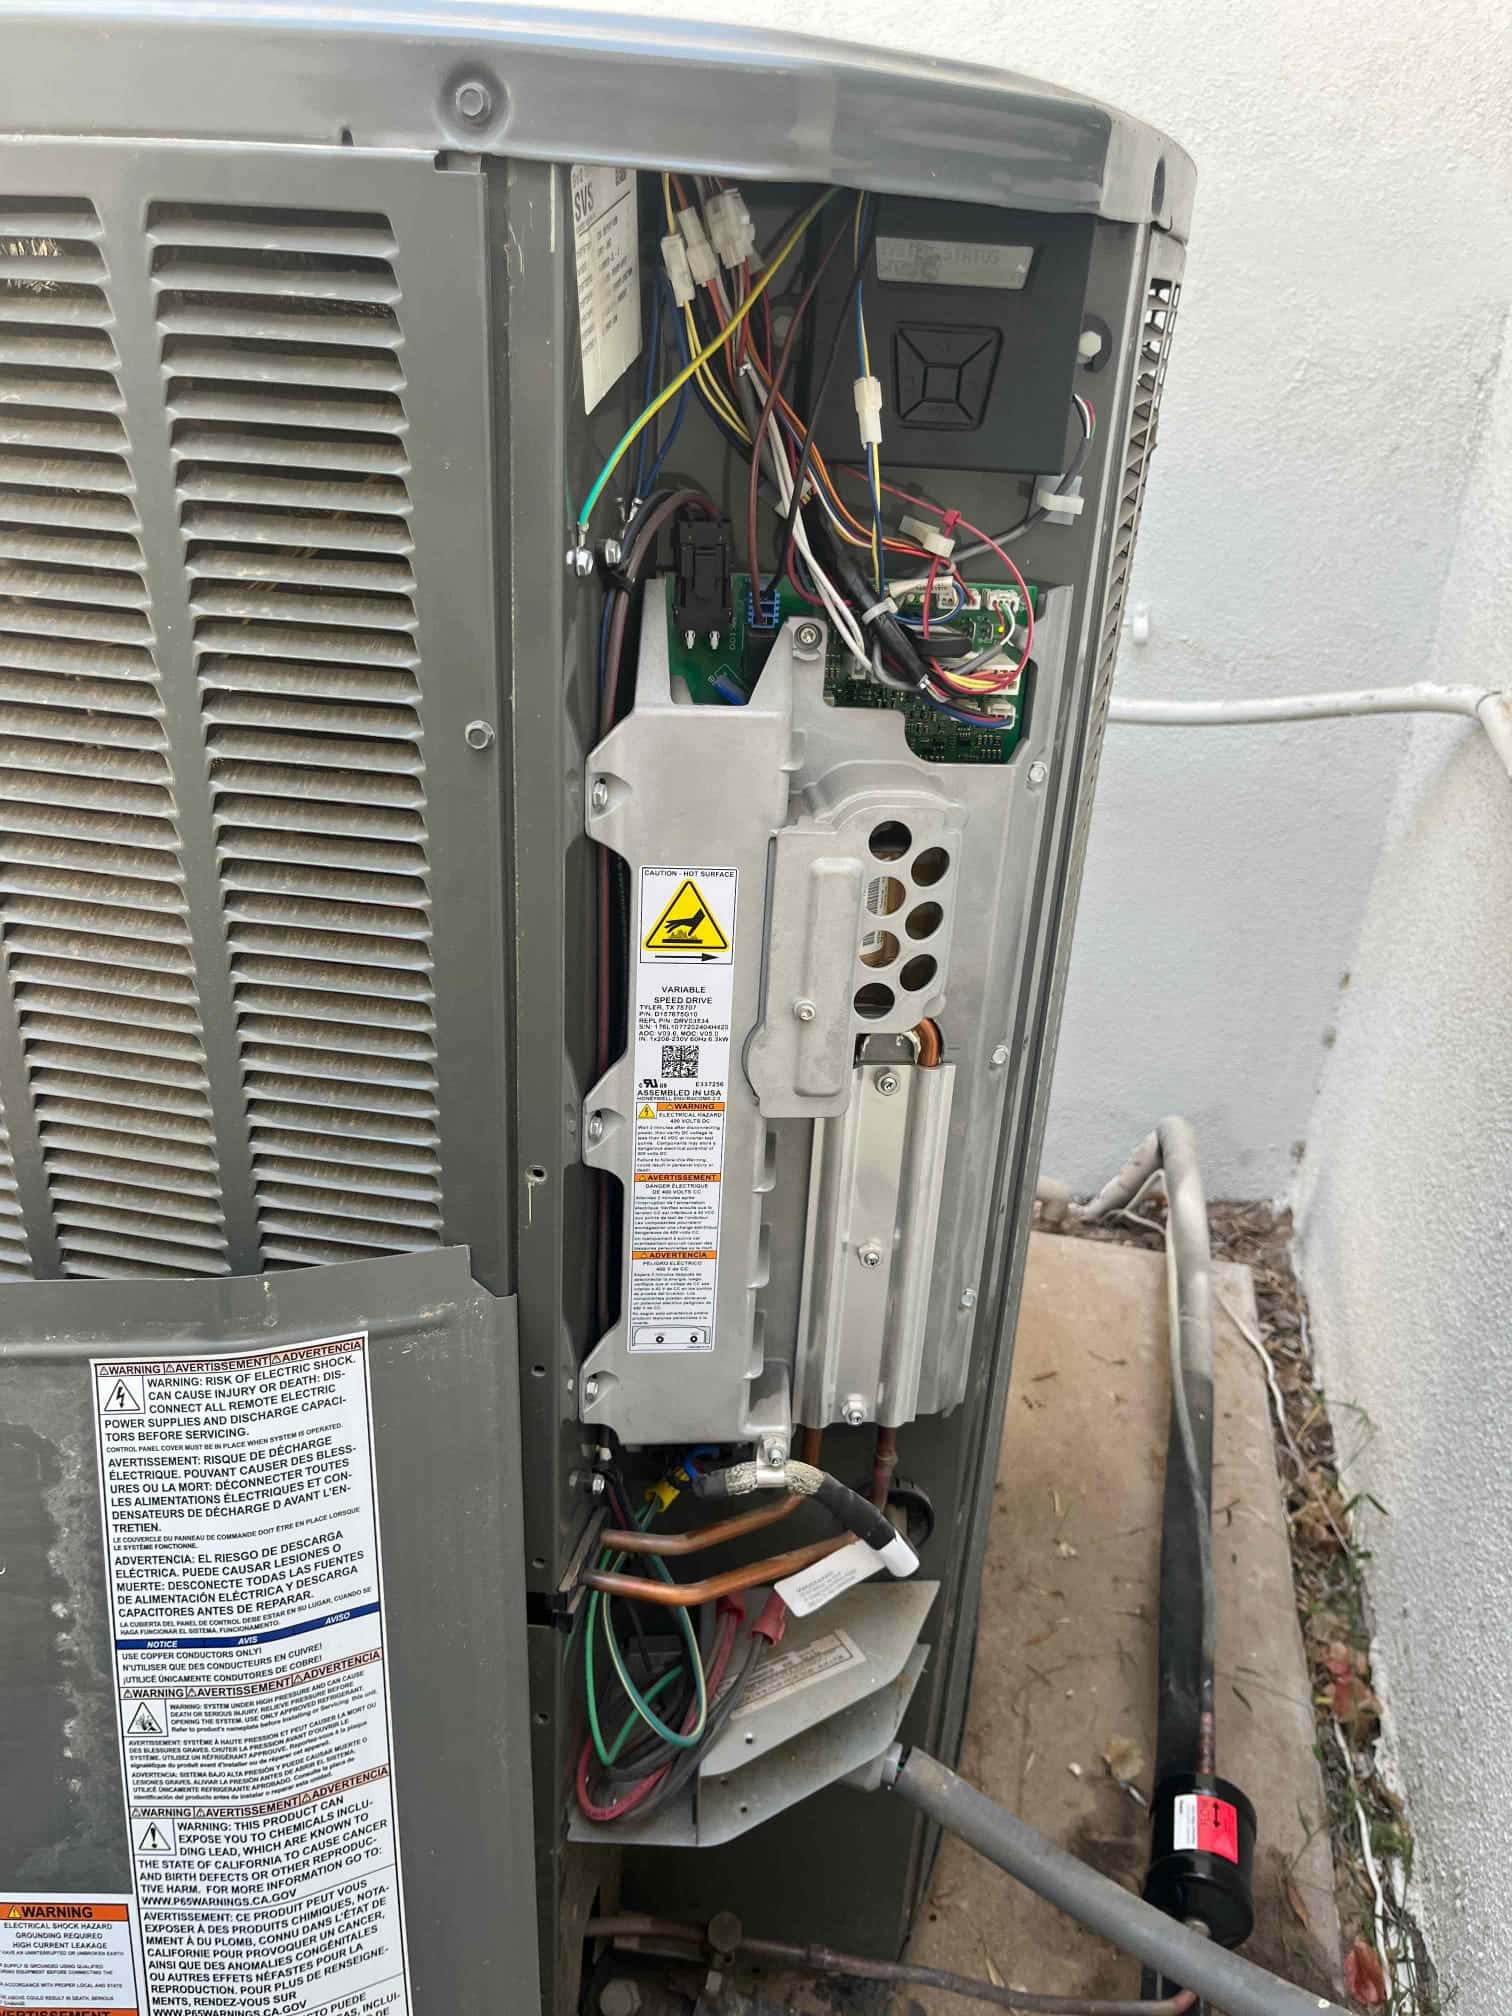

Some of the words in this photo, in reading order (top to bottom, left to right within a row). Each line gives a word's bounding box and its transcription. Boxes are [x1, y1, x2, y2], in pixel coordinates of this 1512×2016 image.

[109, 1365, 160, 1375] WARNING
[176, 1356, 267, 1372] AVERTISSEMENT
[283, 1341, 361, 1361] ADVERTENCIA
[147, 1377, 202, 1387] WARNING:
[205, 1375, 232, 1385] RISK
[234, 1373, 251, 1383] OF
[254, 1363, 310, 1381] ELECTRIC
[313, 1355, 355, 1369] SHOCK.
[148, 1391, 171, 1400] CAN
[174, 1389, 212, 1399] CAUSE
[214, 1385, 256, 1398] INJURY
[259, 1382, 276, 1393] OR
[279, 1374, 320, 1389] DEATH:
[323, 1370, 345, 1381] DIS-
[149, 1403, 202, 1413] CONNECT
[204, 1402, 226, 1411] ALL
[228, 1395, 278, 1410] REMOTE
[280, 1384, 335, 1402] ELECTRIC
[104, 1418, 145, 1428] POWER
[147, 1417, 200, 1427] SUPPLIES
[203, 1416, 227, 1425] AND
[230, 1405, 298, 1423] DISCHARGE
[301, 1396, 346, 1411] CAPACI-
[105, 1432, 135, 1441] TORS
[137, 1430, 182, 1440] BEFORE
[185, 1427, 249, 1439] SERVICING.
[108, 1456, 200, 1467] AVERTISSEMENT:
[203, 1453, 246, 1464] RISQUE
[249, 1450, 265, 1460] DE
[268, 1436, 332, 1457] DÉCHARGE
[109, 1469, 181, 1480] ÉLECTRIQUE.
[183, 1467, 236, 1478] POUVANT
[239, 1459, 288, 1475] CAUSER
[290, 1453, 313, 1465] DES
[316, 1445, 356, 1460] BLESS-
[110, 1484, 139, 1493] URES
[142, 1483, 158, 1492] OU
[161, 1483, 176, 1492] LA
[178, 1482, 212, 1491] MORT:
[215, 1469, 302, 1490] DÉCONNECTER
[304, 1458, 349, 1475] TOUTES
[111, 1497, 131, 1506] LES
[134, 1495, 220, 1505] ALIMENTATIONS
[223, 1481, 304, 1503] ÉLECTRIQUES
[307, 1477, 321, 1488] ET
[324, 1472, 352, 1484] CON-
[112, 1509, 184, 1519] DENSATEURS
[187, 1508, 202, 1517] DE
[205, 1502, 270, 1516] DÉCHARGE
[272, 1500, 281, 1509] D
[284, 1491, 320, 1506] AVANT
[323, 1485, 350, 1497] L'EN-
[112, 1522, 161, 1532] TRETIEN.
[238, 1636, 259, 1645] AVIS
[324, 1612, 351, 1625] AVISO
[175, 1650, 233, 1659] CONDUCTORS
[235, 1647, 261, 1657] ONLY!
[133, 1688, 184, 1698] WARNING
[198, 1678, 289, 1697] AVERTISSEMENT
[303, 1650, 380, 1680] ADVERTENCIA
[141, 1807, 191, 1817] WARNING
[206, 1797, 299, 1817] AVERTISSEMENT
[312, 1767, 388, 1799] ADVERTENCIA
[176, 1822, 231, 1831] WARNING:
[233, 1820, 260, 1830] THIS
[263, 1804, 317, 1827] PRODUCT
[320, 1796, 343, 1810] CAN
[178, 1834, 221, 1843] EXPOSE
[224, 1834, 247, 1843] YOU
[250, 1832, 266, 1841] TO
[269, 1812, 334, 1838] CHEMICALS
[337, 1800, 372, 1817] INCLU-
[139, 1859, 159, 1868] THE
[162, 1860, 194, 1869] STATE
[197, 1860, 211, 1869] OF
[214, 1855, 282, 1869] CALIFORNIA
[284, 1850, 299, 1861] TO
[302, 1835, 340, 1855] CAUSE
[342, 1819, 387, 1841] CANCER
[179, 1847, 206, 1856] DING
[208, 1847, 240, 1856] LEAD,
[242, 1841, 281, 1855] WHICH
[284, 1833, 307, 1848] ARE
[310, 1818, 351, 1839] KNOWN
[354, 1812, 368, 1823] TO
[139, 1872, 162, 1880] AND
[164, 1872, 196, 1880] BIRTH
[199, 1872, 248, 1881] DEFECTS
[251, 1870, 268, 1880] OR
[271, 1859, 310, 1876] OTHER
[312, 1836, 376, 1864] REPRODUC-
[141, 1884, 163, 1893] TIVE
[166, 1884, 200, 1893] HARM.
[206, 1885, 228, 1894] FOR
[231, 1883, 263, 1894] MORE
[266, 1860, 342, 1890] INFORMATION
[345, 1853, 361, 1865] GO
[364, 1847, 381, 1858] TO:
[22, 1907, 93, 1918] WARNING
